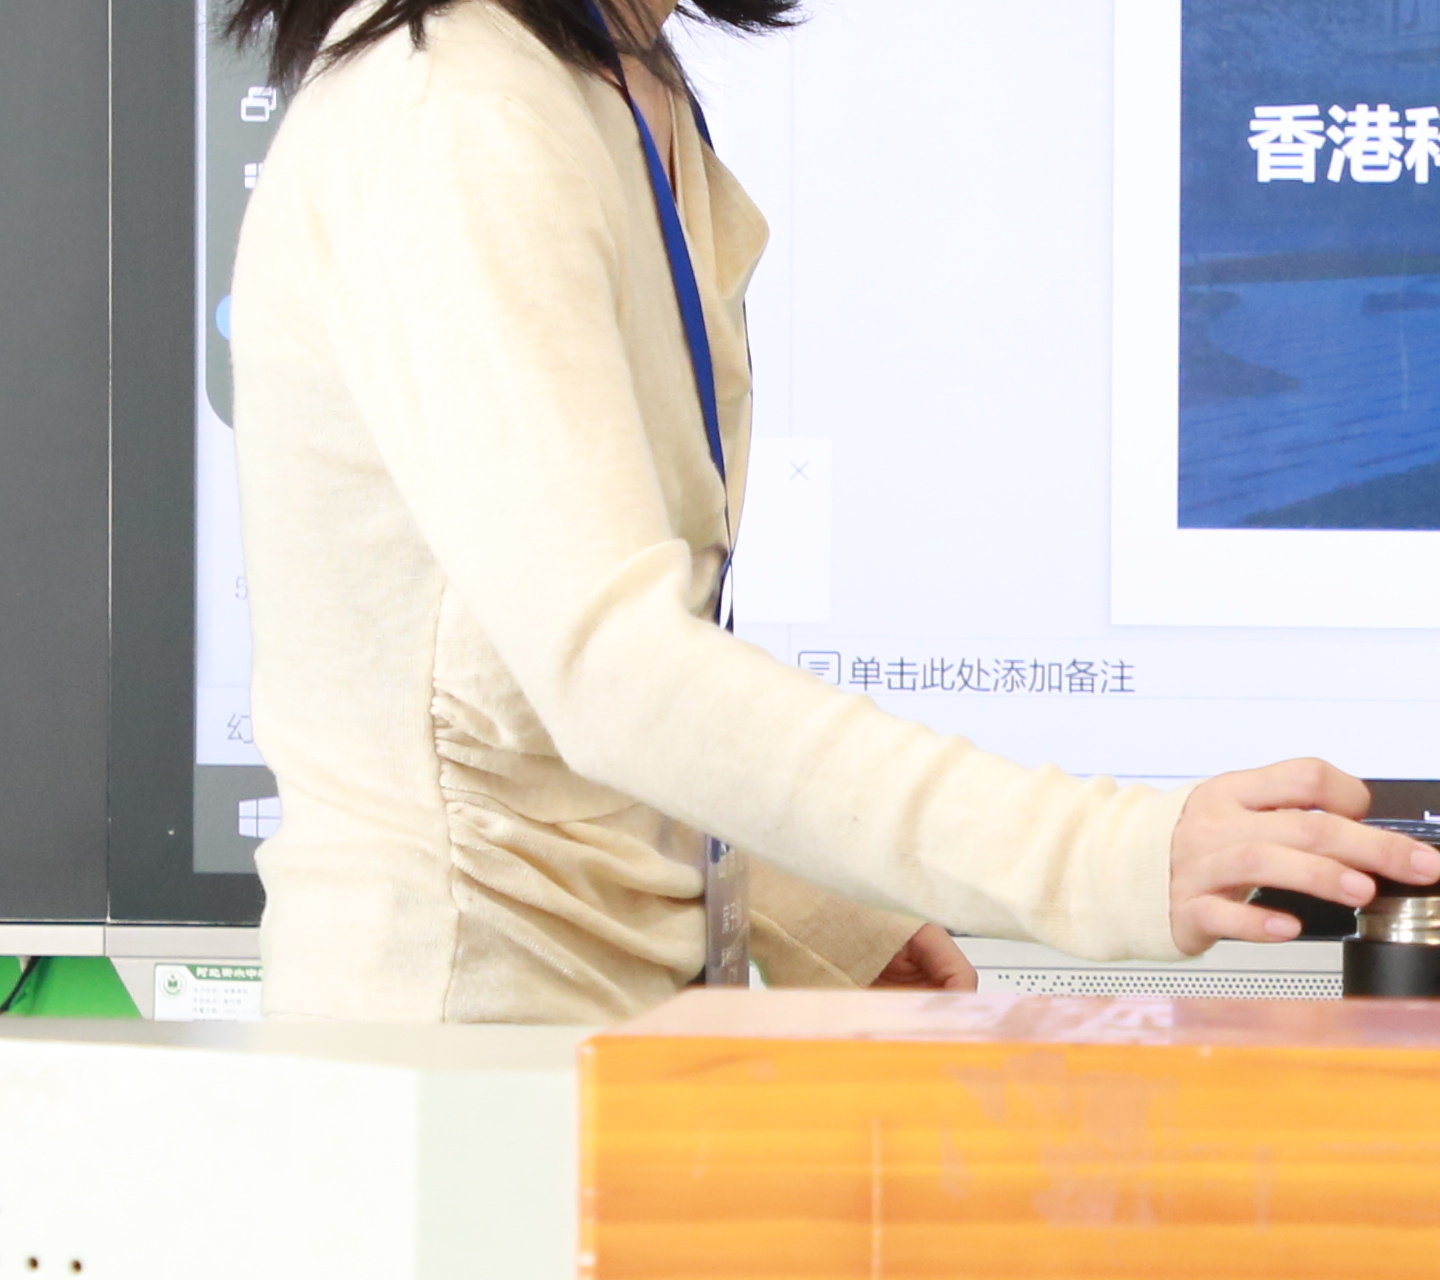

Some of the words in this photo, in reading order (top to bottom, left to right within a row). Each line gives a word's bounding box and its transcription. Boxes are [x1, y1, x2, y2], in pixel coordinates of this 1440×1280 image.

[848, 655, 1136, 695] 单击此处添加备注
